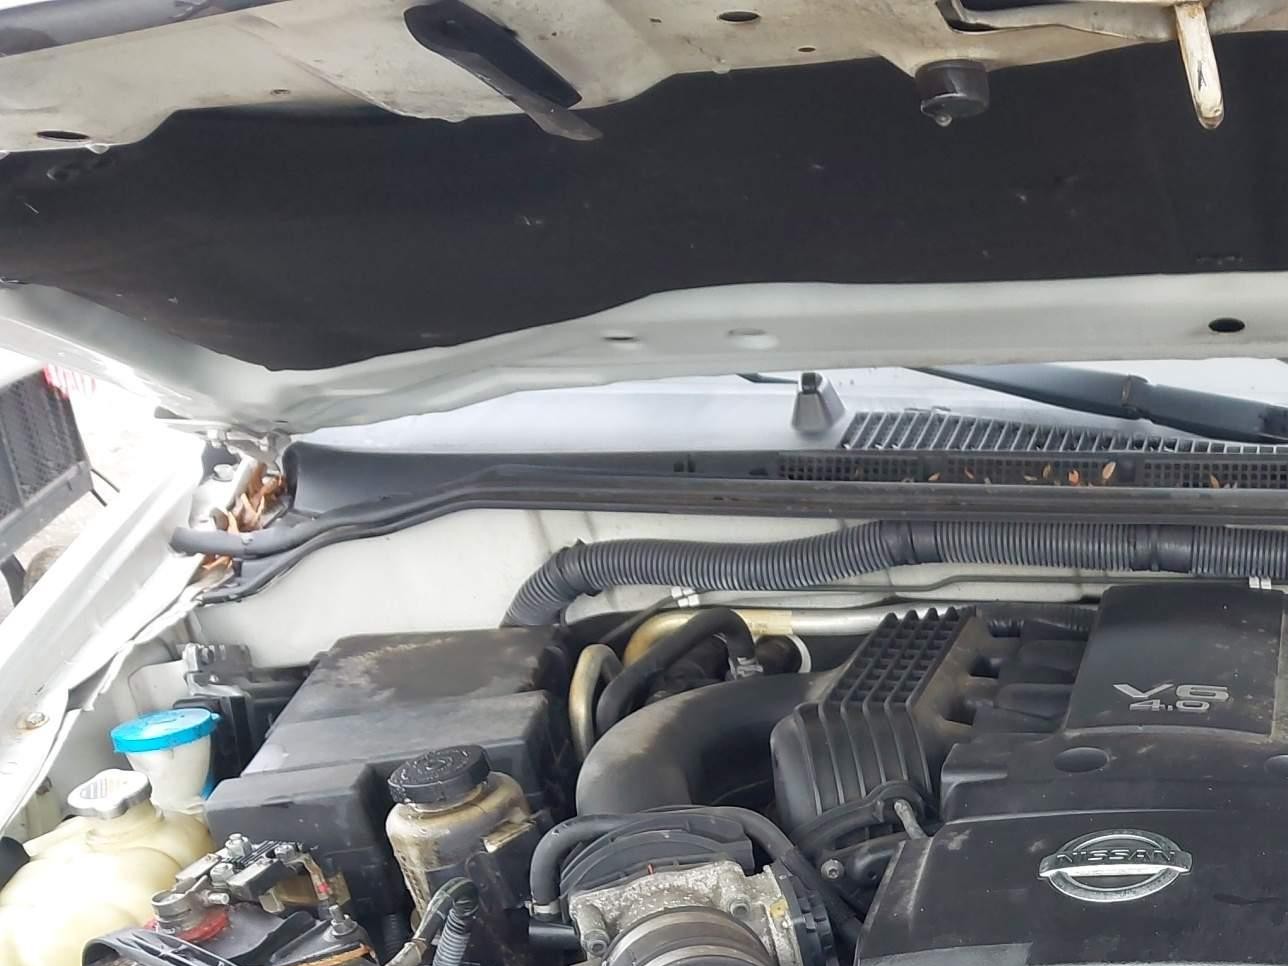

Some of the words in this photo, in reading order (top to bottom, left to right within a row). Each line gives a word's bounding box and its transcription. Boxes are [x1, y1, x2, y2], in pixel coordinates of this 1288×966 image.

[1112, 683, 1230, 702] V6
[1129, 699, 1210, 712] 4.0
[1056, 849, 1176, 863] NISSAN
